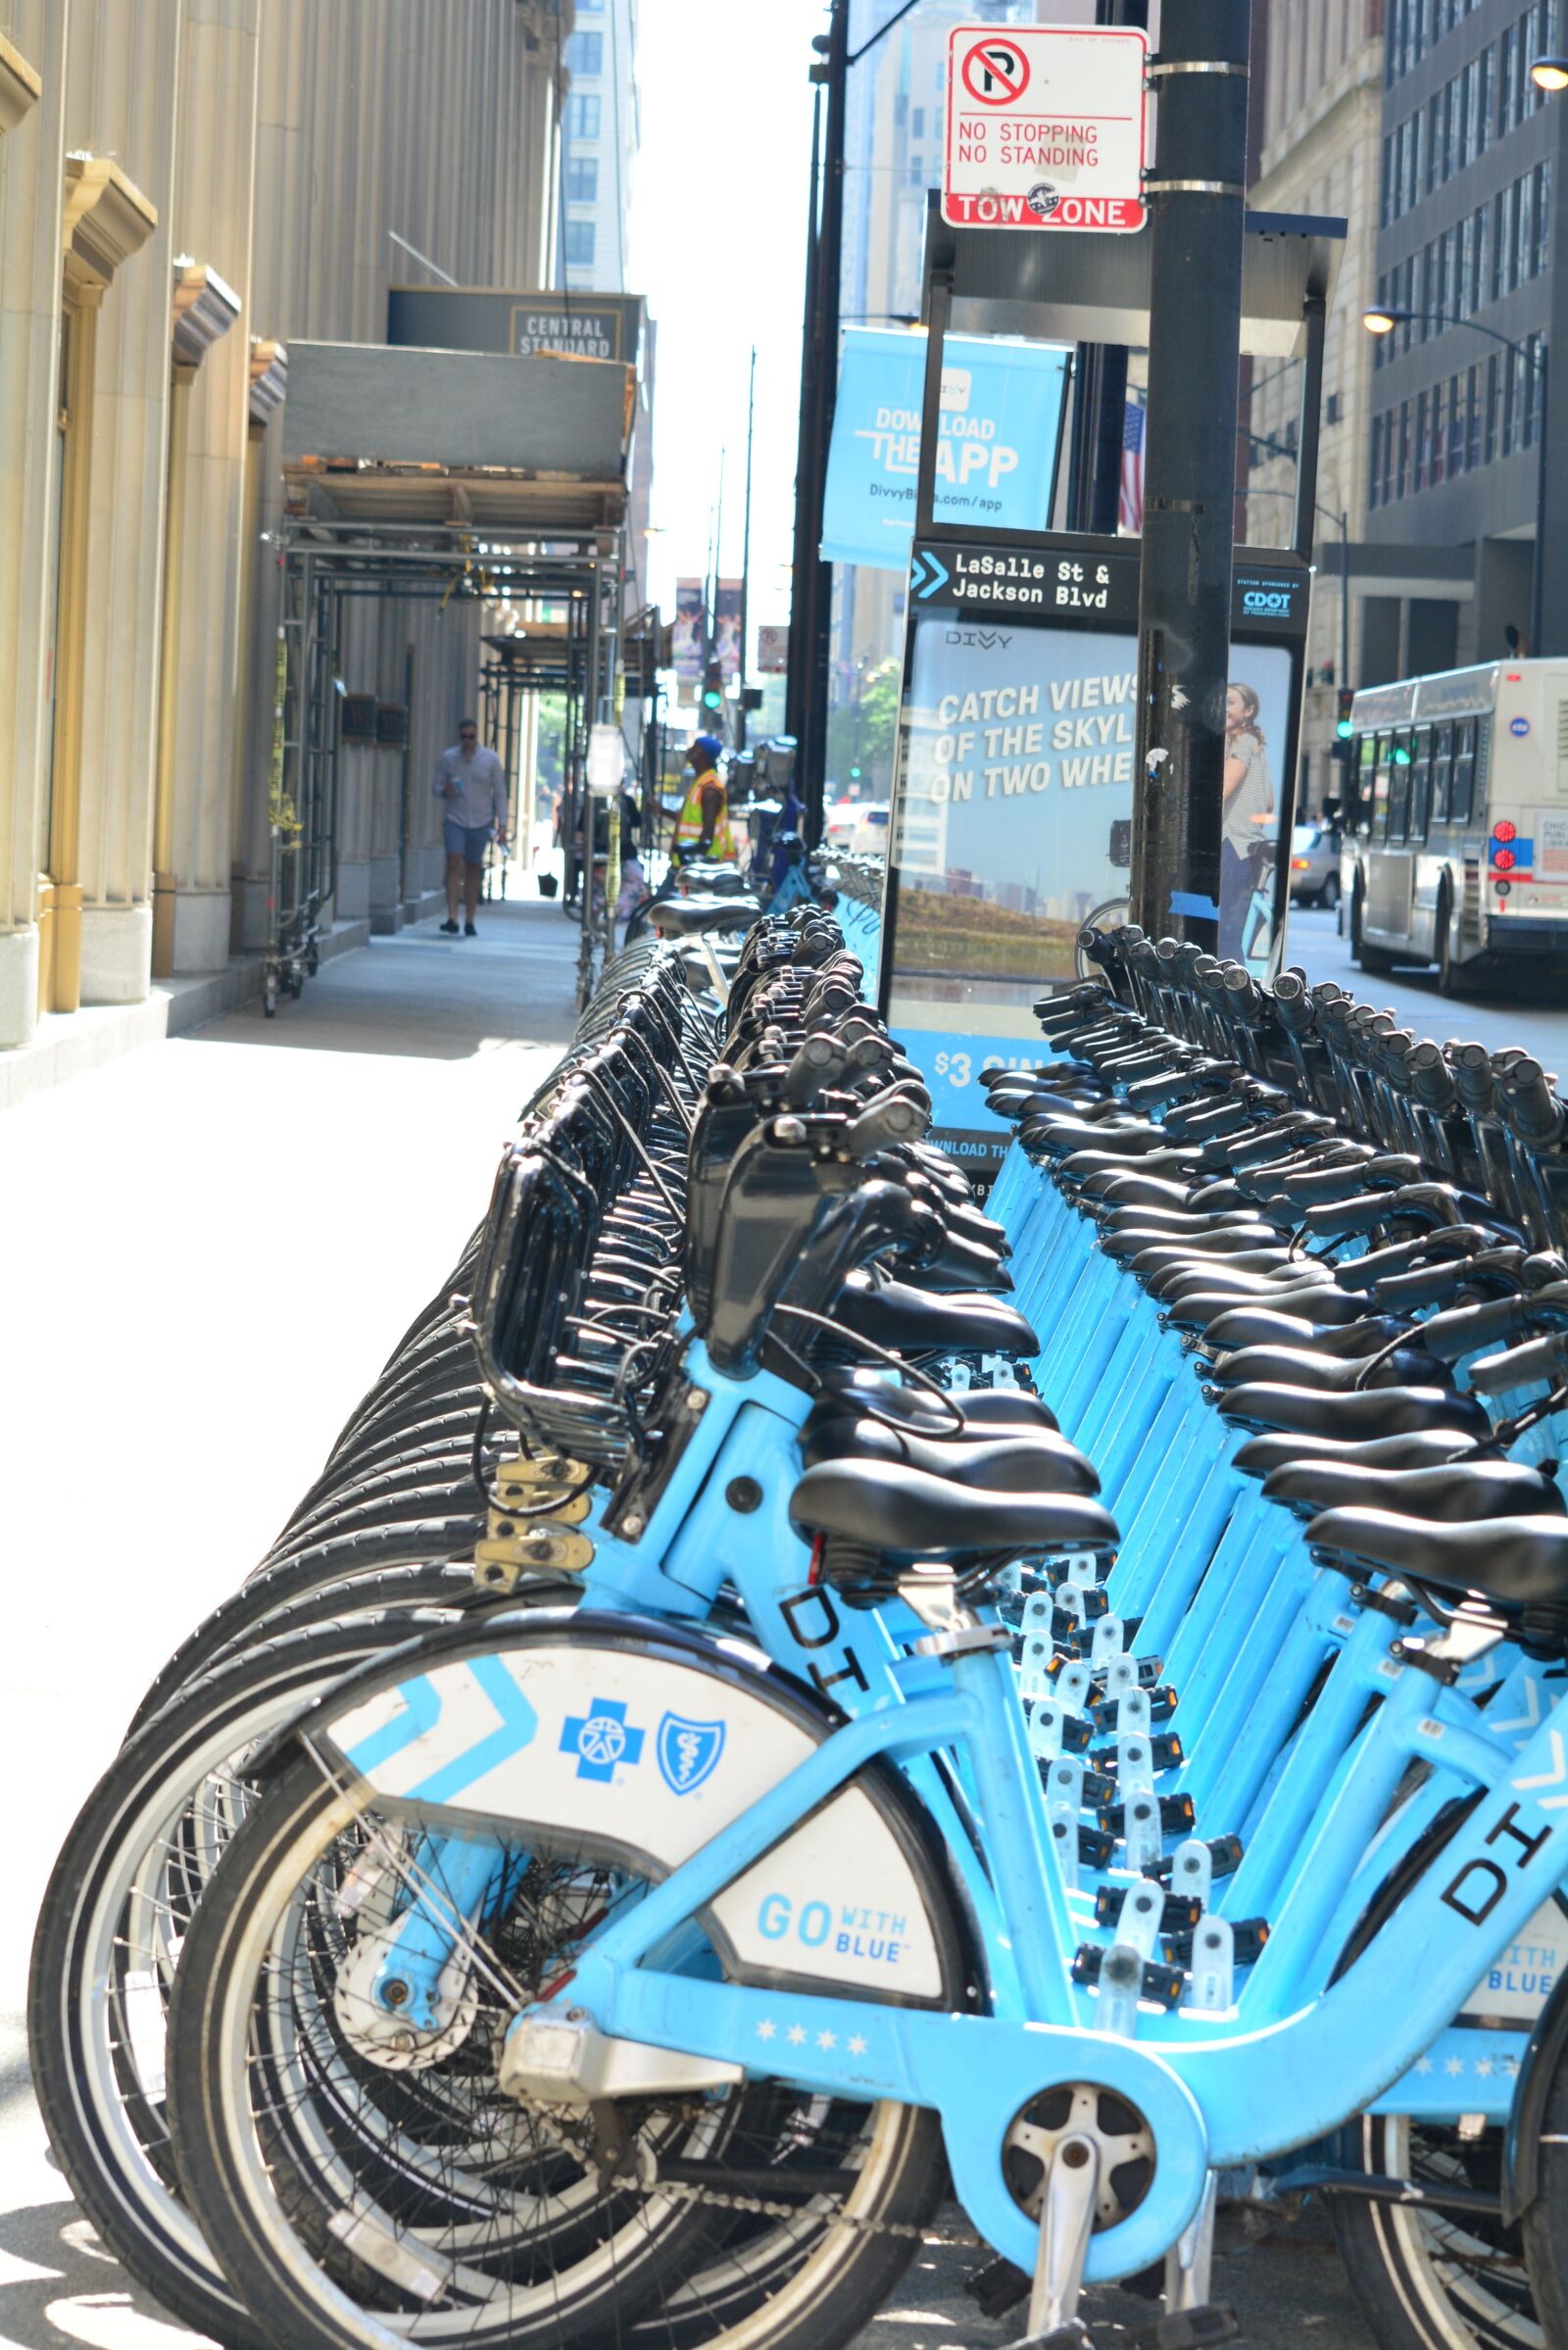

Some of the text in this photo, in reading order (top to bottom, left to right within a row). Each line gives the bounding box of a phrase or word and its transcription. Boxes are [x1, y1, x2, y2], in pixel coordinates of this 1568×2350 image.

[959, 122, 1098, 144] NO STOPPING
[958, 145, 1099, 166] NO STANDING
[958, 196, 1023, 222] TOW
[527, 316, 604, 338] CENTRAL
[520, 335, 610, 358] STANDARD
[876, 408, 995, 440] DOWLOAD
[855, 429, 1019, 488] THE APP
[956, 554, 1109, 584] LaSalle St &
[953, 578, 1107, 609] Jackson Blvd
[1244, 591, 1291, 609] CDOT
[939, 684, 1040, 725] CATCH
[934, 731, 975, 764] OF
[984, 722, 1044, 759] THE
[931, 770, 974, 805] ON
[984, 760, 1052, 798] TWO
[934, 1052, 971, 1088] $3
[758, 1892, 907, 1948] GO WITH
[1503, 1944, 1556, 1969] ITH
[1488, 1970, 1553, 1995] BLUE
